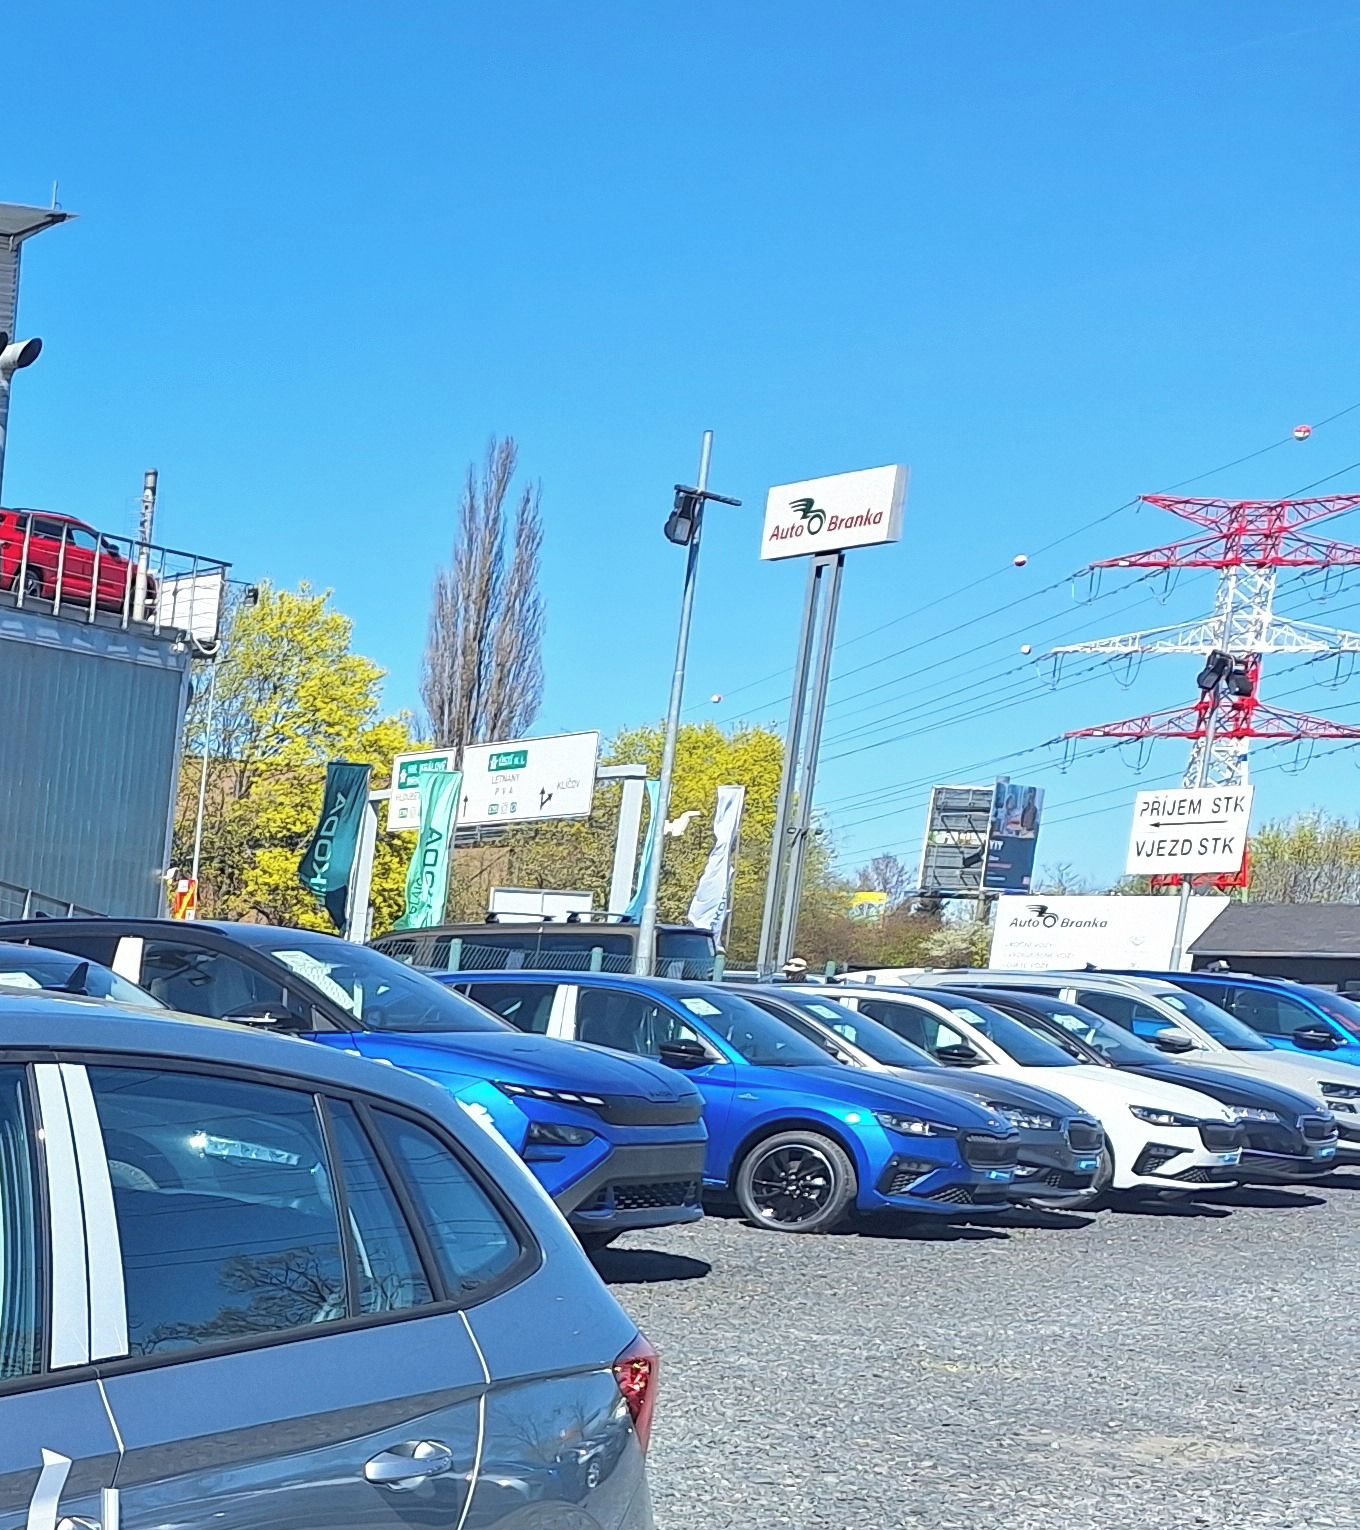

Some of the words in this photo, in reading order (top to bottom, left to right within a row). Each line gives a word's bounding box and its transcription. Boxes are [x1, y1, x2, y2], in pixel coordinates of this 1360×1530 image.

[768, 524, 804, 542] Auto
[827, 508, 884, 532] Branka
[1140, 794, 1202, 817] PŘÍJEM
[1211, 796, 1246, 814] STK
[1135, 839, 1193, 857] VJEZD
[1197, 836, 1236, 856] STK
[1009, 917, 1040, 928] Auto
[1060, 918, 1108, 928] Branka
